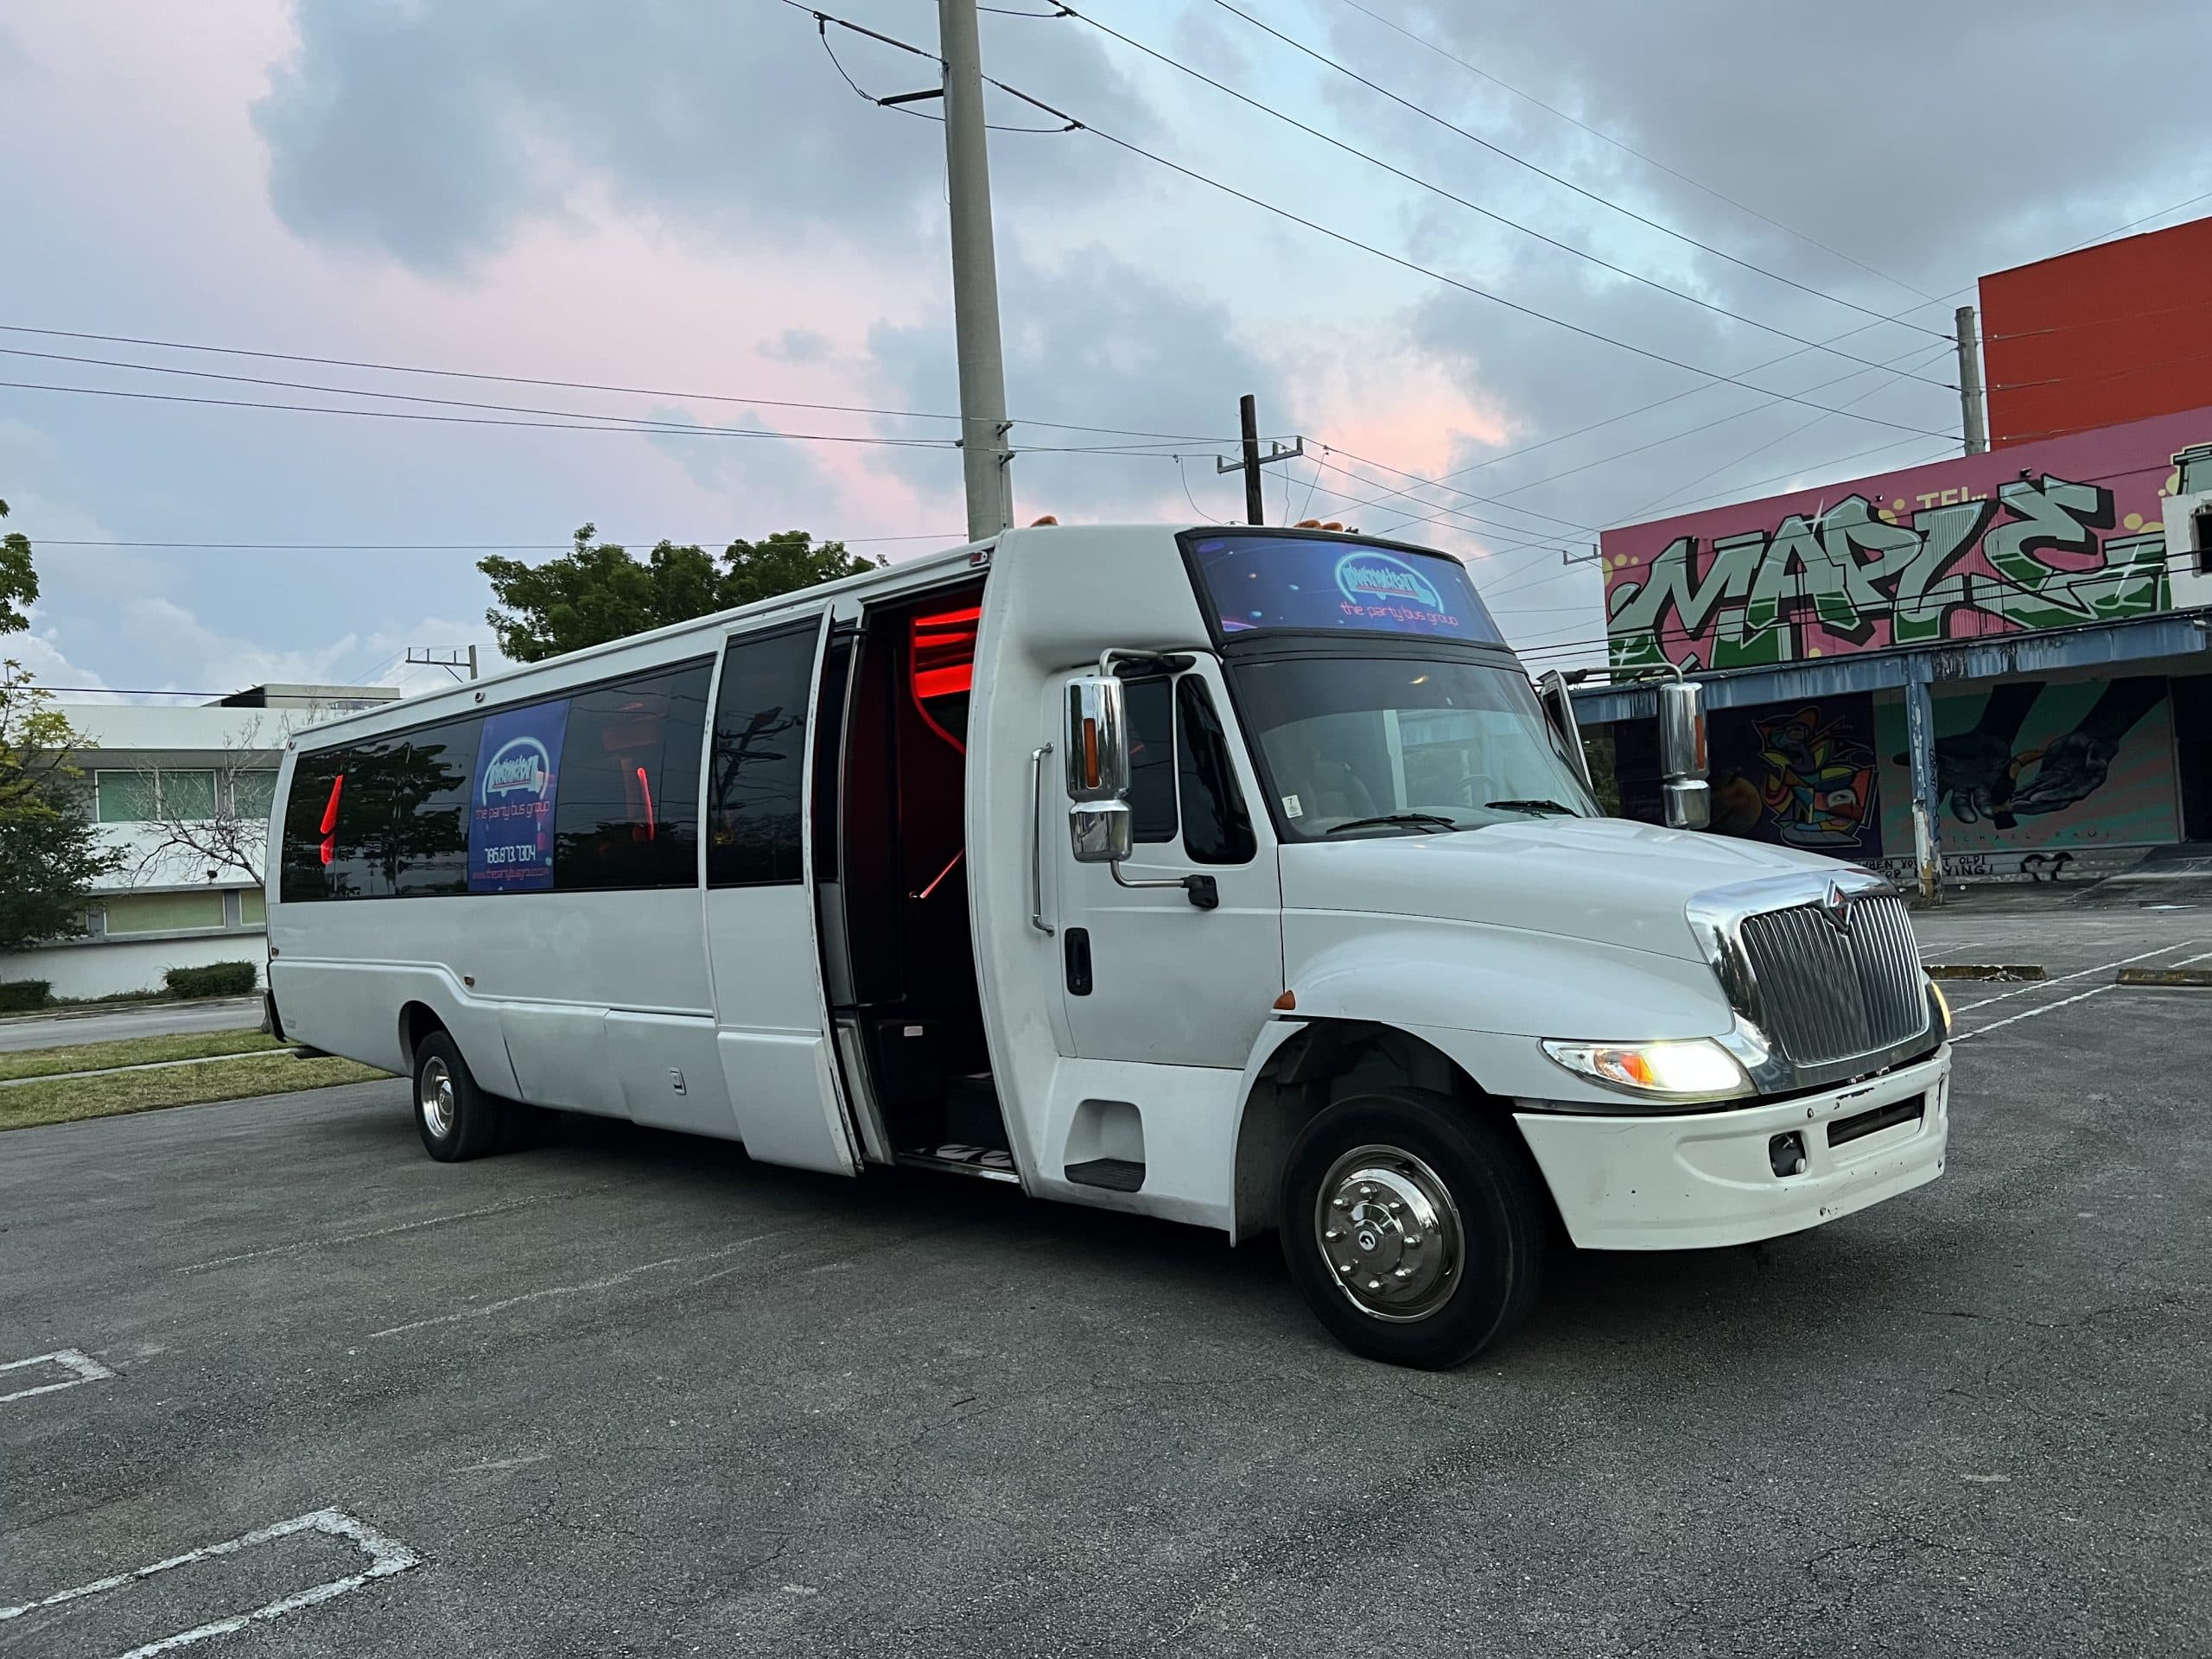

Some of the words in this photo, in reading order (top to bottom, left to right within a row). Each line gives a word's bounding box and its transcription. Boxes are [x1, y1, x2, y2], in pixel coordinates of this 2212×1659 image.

[1340, 601, 1364, 615] the
[1367, 607, 1404, 622] party
[1403, 606, 1426, 620] bus
[1426, 613, 1459, 627] group
[489, 807, 510, 821] party
[511, 802, 525, 816] bus
[526, 801, 550, 818] group
